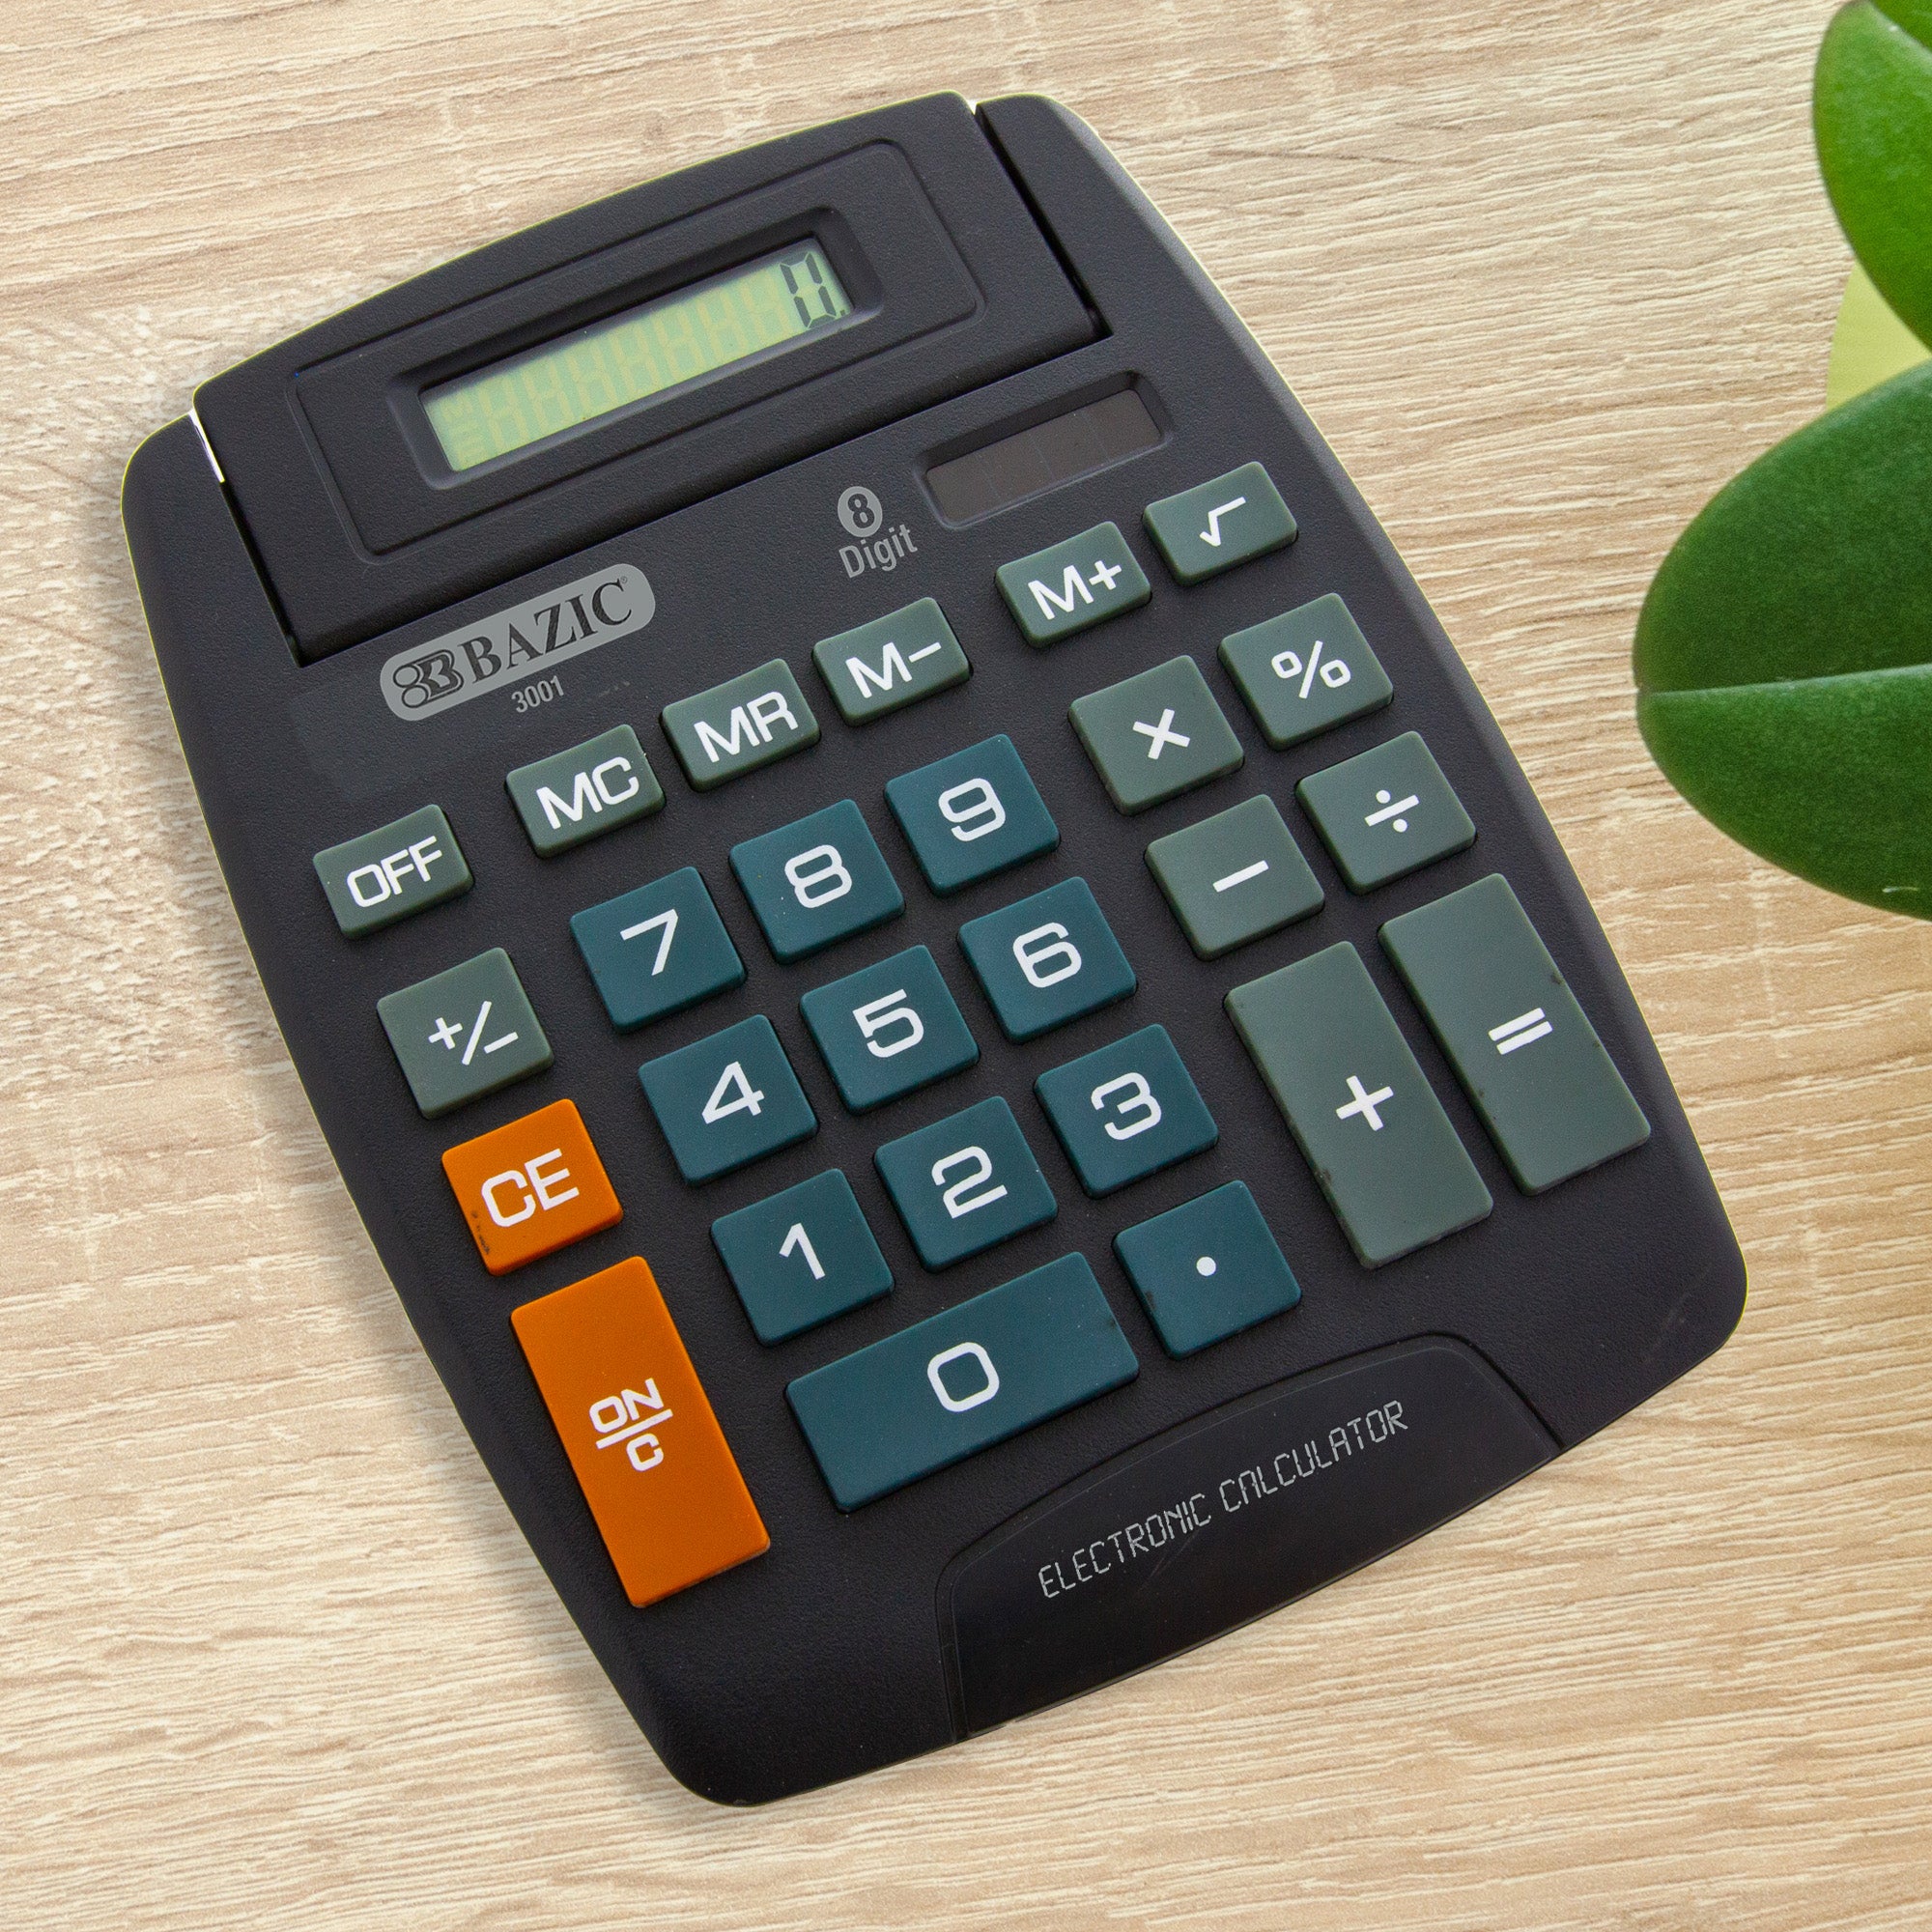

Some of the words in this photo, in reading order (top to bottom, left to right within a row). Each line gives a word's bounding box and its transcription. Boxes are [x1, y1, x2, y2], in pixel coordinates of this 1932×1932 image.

[847, 493, 875, 529] 8
[838, 524, 918, 579] Digit
[1027, 560, 1122, 620] M+
[457, 578, 632, 684] BAZIC
[511, 675, 564, 713] 3001
[1271, 639, 1352, 699] %
[693, 691, 800, 763] MR
[536, 755, 639, 830] MC
[937, 777, 1007, 842] 9
[346, 835, 443, 908] OFF
[784, 843, 853, 909] 8
[619, 908, 679, 977] 7
[1012, 922, 1083, 988] 6
[852, 988, 924, 1059] 5
[1488, 1007, 1553, 1056] =
[701, 1061, 765, 1124] 4
[1090, 1071, 1162, 1141] 3
[1335, 1075, 1395, 1132] +
[481, 1149, 579, 1228] CE
[931, 1146, 1009, 1219] 2
[779, 1222, 826, 1280] 1
[588, 1378, 665, 1434] ON
[926, 1342, 1000, 1412] 0
[626, 1434, 665, 1471] C
[1038, 1493, 1211, 1598] ELECTRONIC
[1219, 1400, 1408, 1513] CALCULATOR
